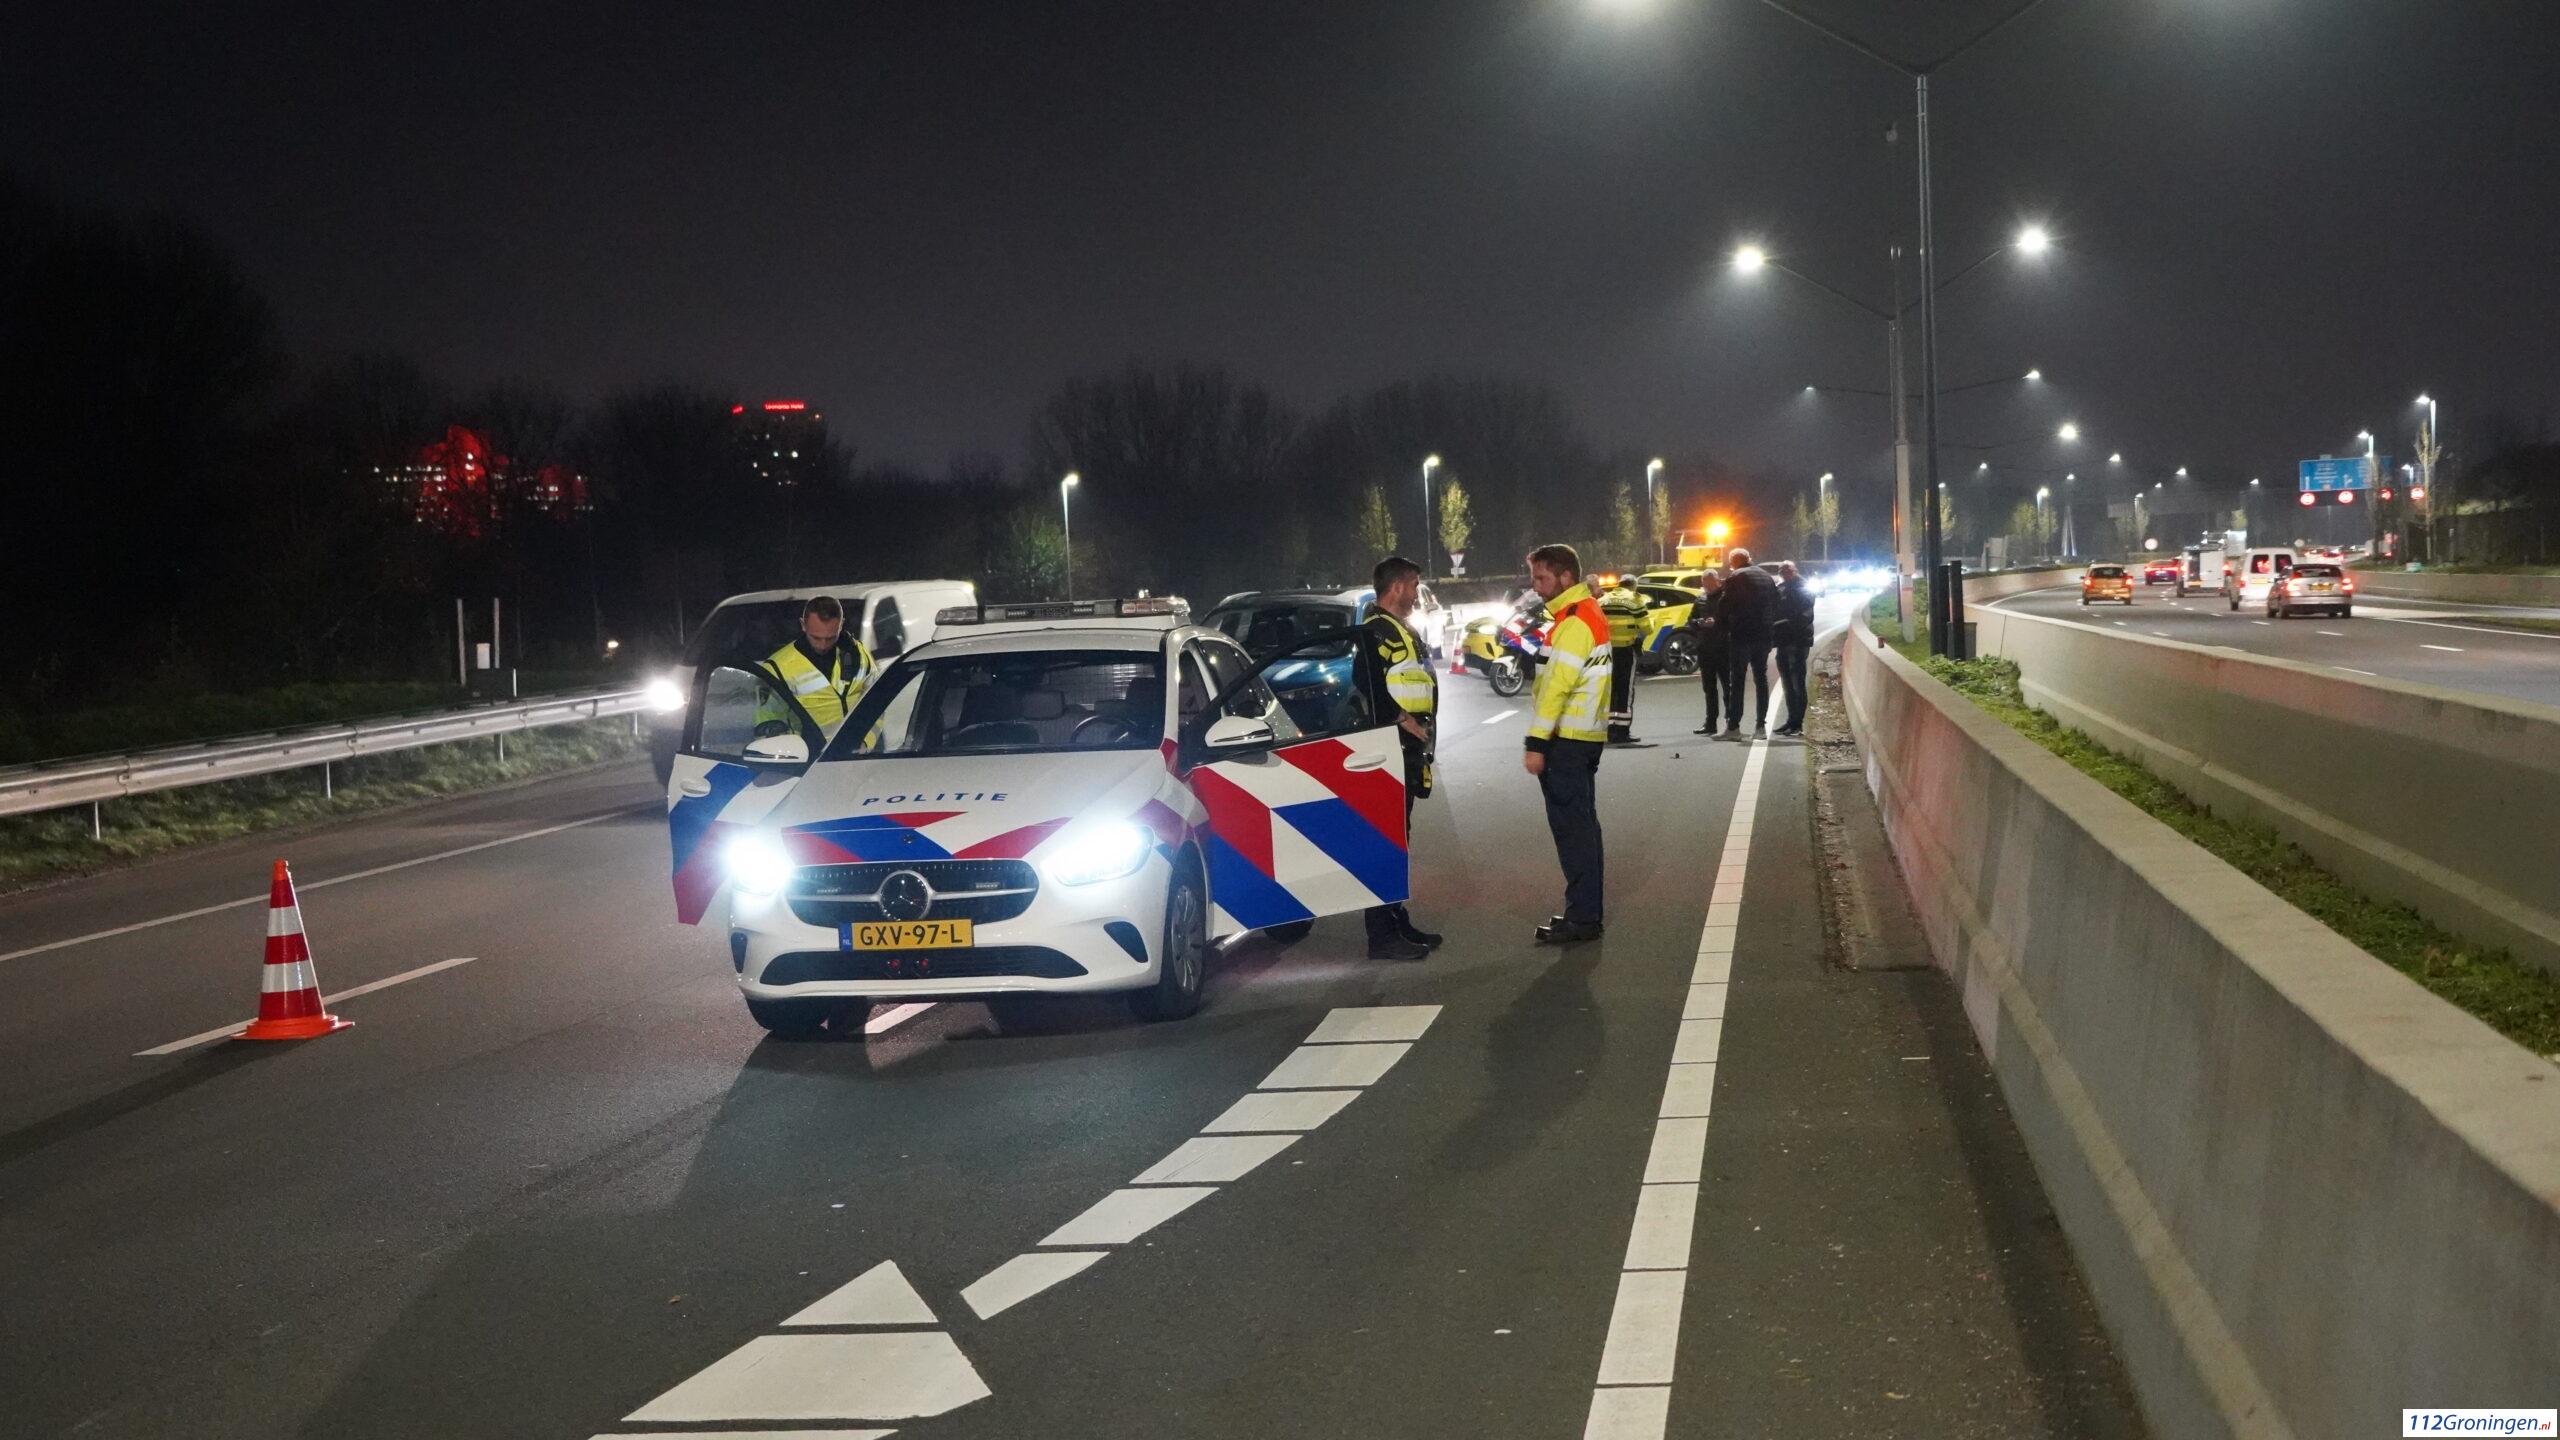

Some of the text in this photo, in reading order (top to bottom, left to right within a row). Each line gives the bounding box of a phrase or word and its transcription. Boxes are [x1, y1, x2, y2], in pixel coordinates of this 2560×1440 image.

[862, 792, 1008, 806] POLITIE
[860, 923, 963, 946] GXV-97-L
[842, 938, 851, 946] NL
